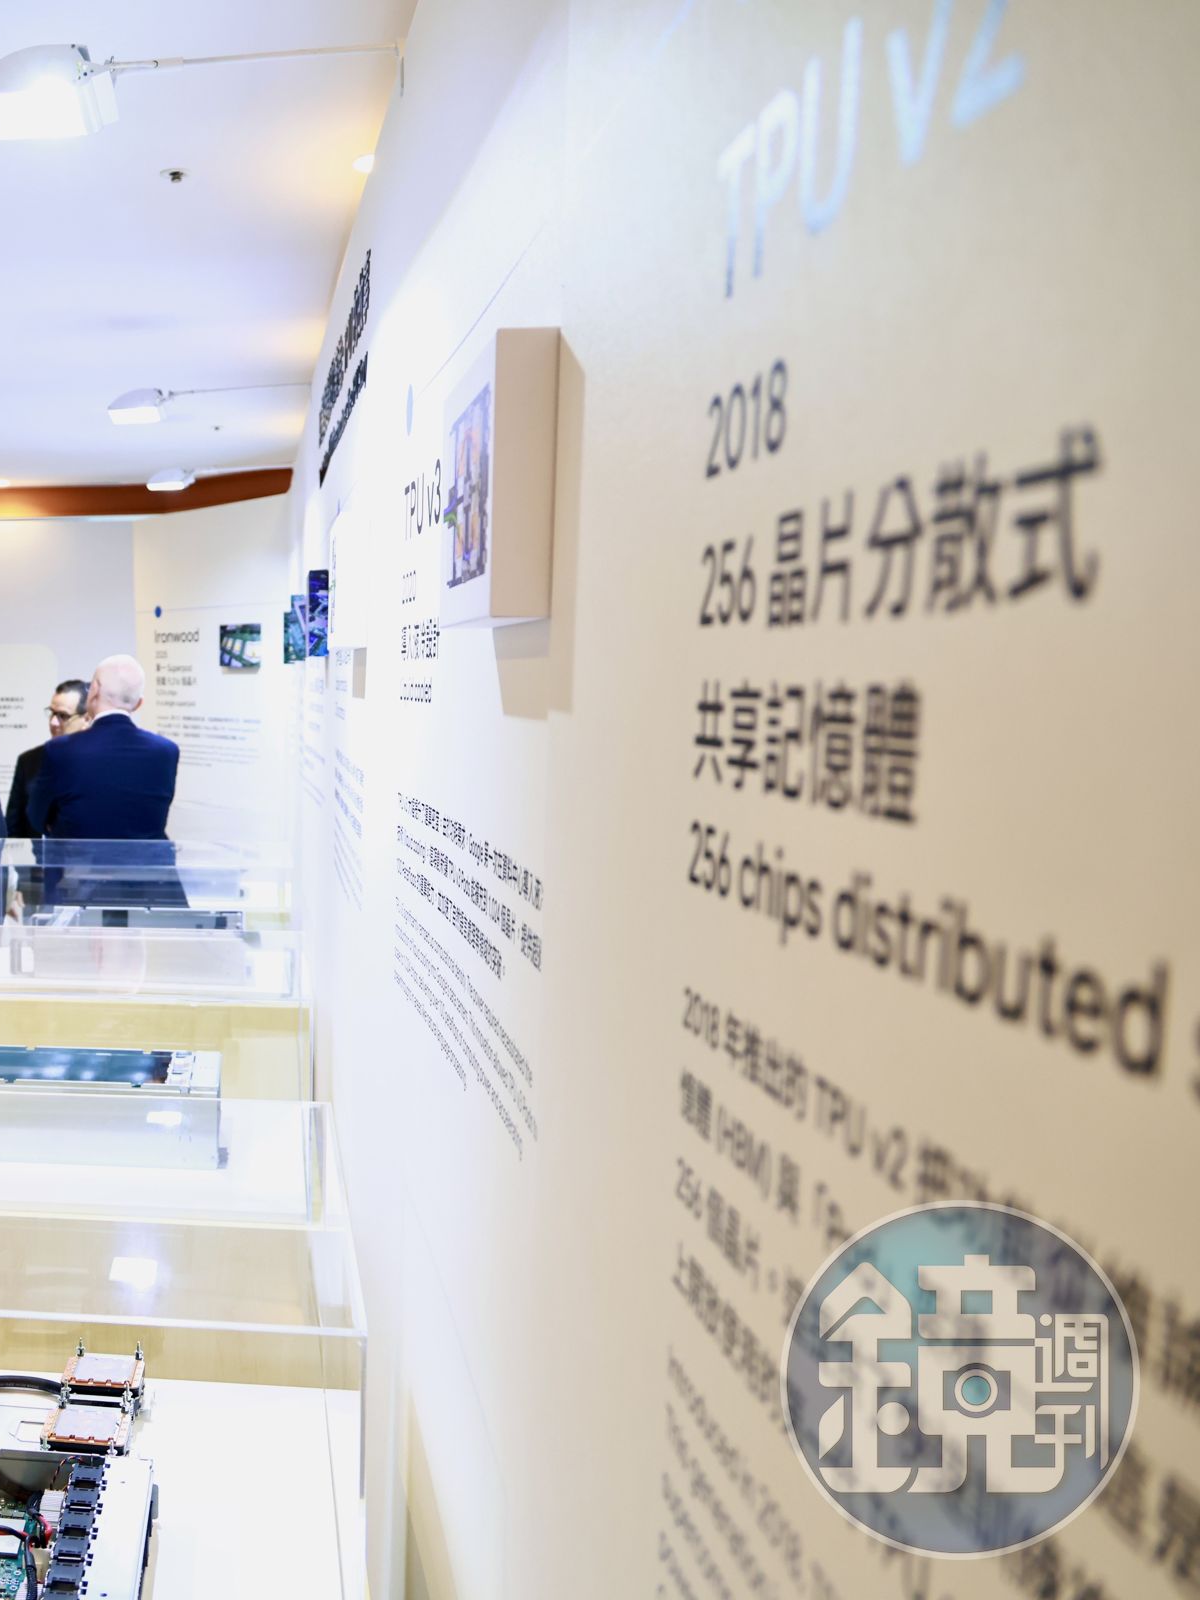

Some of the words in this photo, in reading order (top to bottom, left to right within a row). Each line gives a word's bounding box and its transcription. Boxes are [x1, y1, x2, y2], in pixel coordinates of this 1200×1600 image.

[717, 15, 863, 298] TPU
[706, 358, 790, 480] 2018
[404, 471, 424, 542] TPU
[427, 458, 442, 529] v3
[699, 535, 757, 627] 256
[767, 424, 1101, 628] 晶片分散式
[154, 628, 199, 644] Ironwood
[693, 678, 921, 827] 共享記憶體
[689, 820, 731, 899] 256
[740, 843, 823, 947] chips
[833, 871, 1171, 1080] distributed
